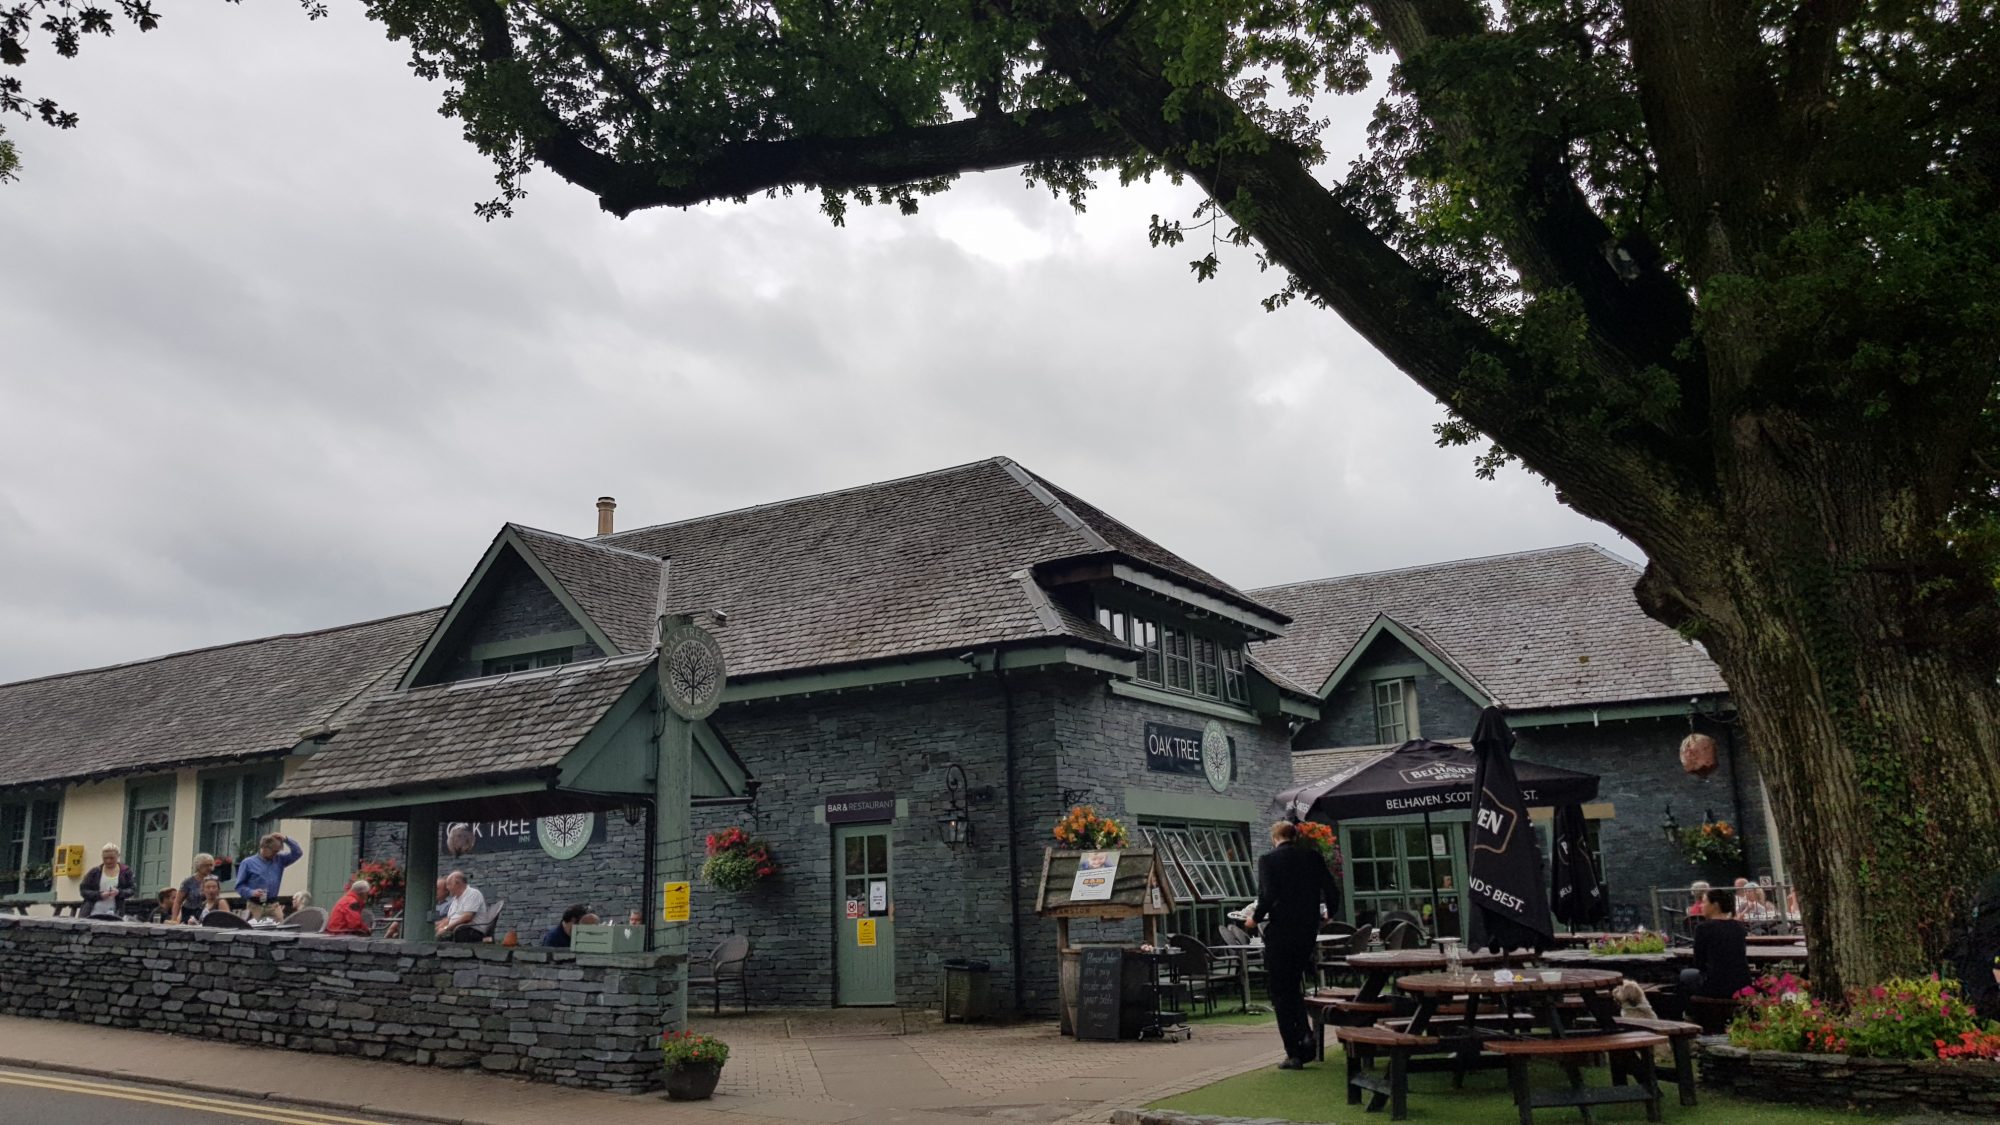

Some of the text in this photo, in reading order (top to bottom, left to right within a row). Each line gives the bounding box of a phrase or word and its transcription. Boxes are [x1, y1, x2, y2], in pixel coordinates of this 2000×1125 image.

[664, 627, 723, 664] OAK TREE INN
[1149, 734, 1173, 757] OAK
[1174, 737, 1200, 761] TREE
[827, 800, 894, 812] BAR & RESTAURANT
[1386, 789, 1539, 810] BELHAVEN. SCOT ST.
[491, 819, 531, 837] TREE
[1477, 807, 1504, 835] EN
[518, 835, 531, 844] INN
[1492, 889, 1525, 913] BEST.
